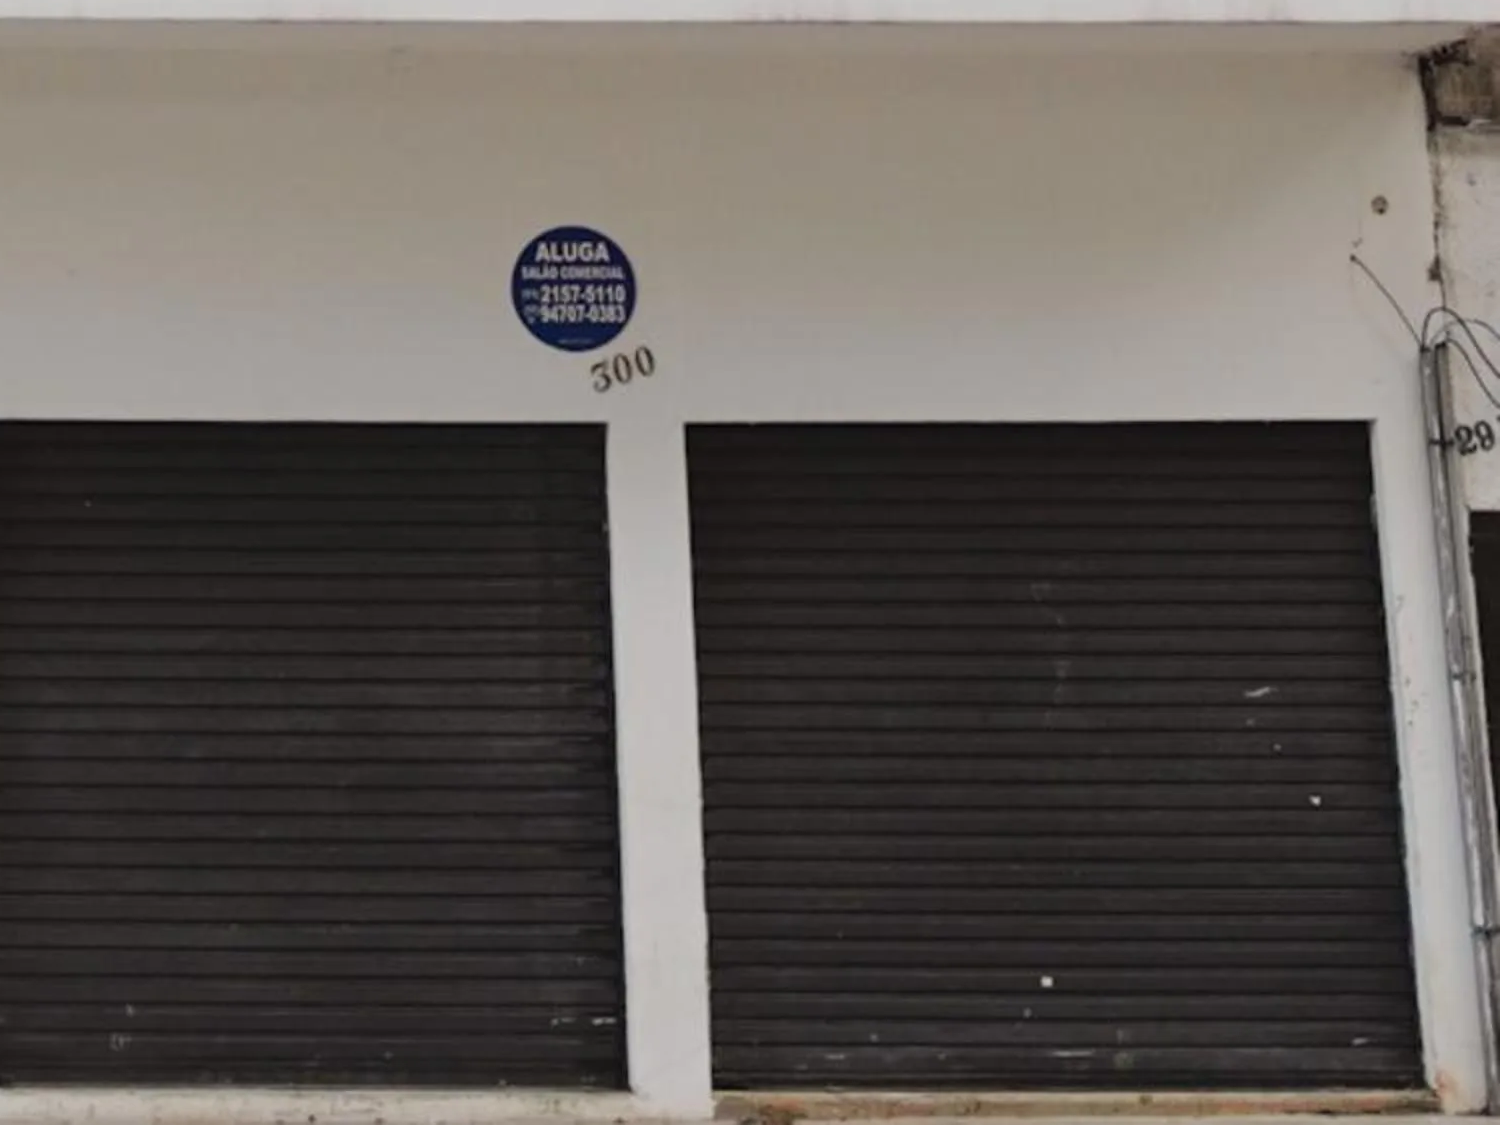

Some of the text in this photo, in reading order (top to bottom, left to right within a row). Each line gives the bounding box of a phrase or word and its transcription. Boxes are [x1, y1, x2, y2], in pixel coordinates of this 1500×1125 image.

[535, 241, 610, 262] ALUGA
[590, 345, 655, 393] 300
[1454, 417, 1500, 456] 29
